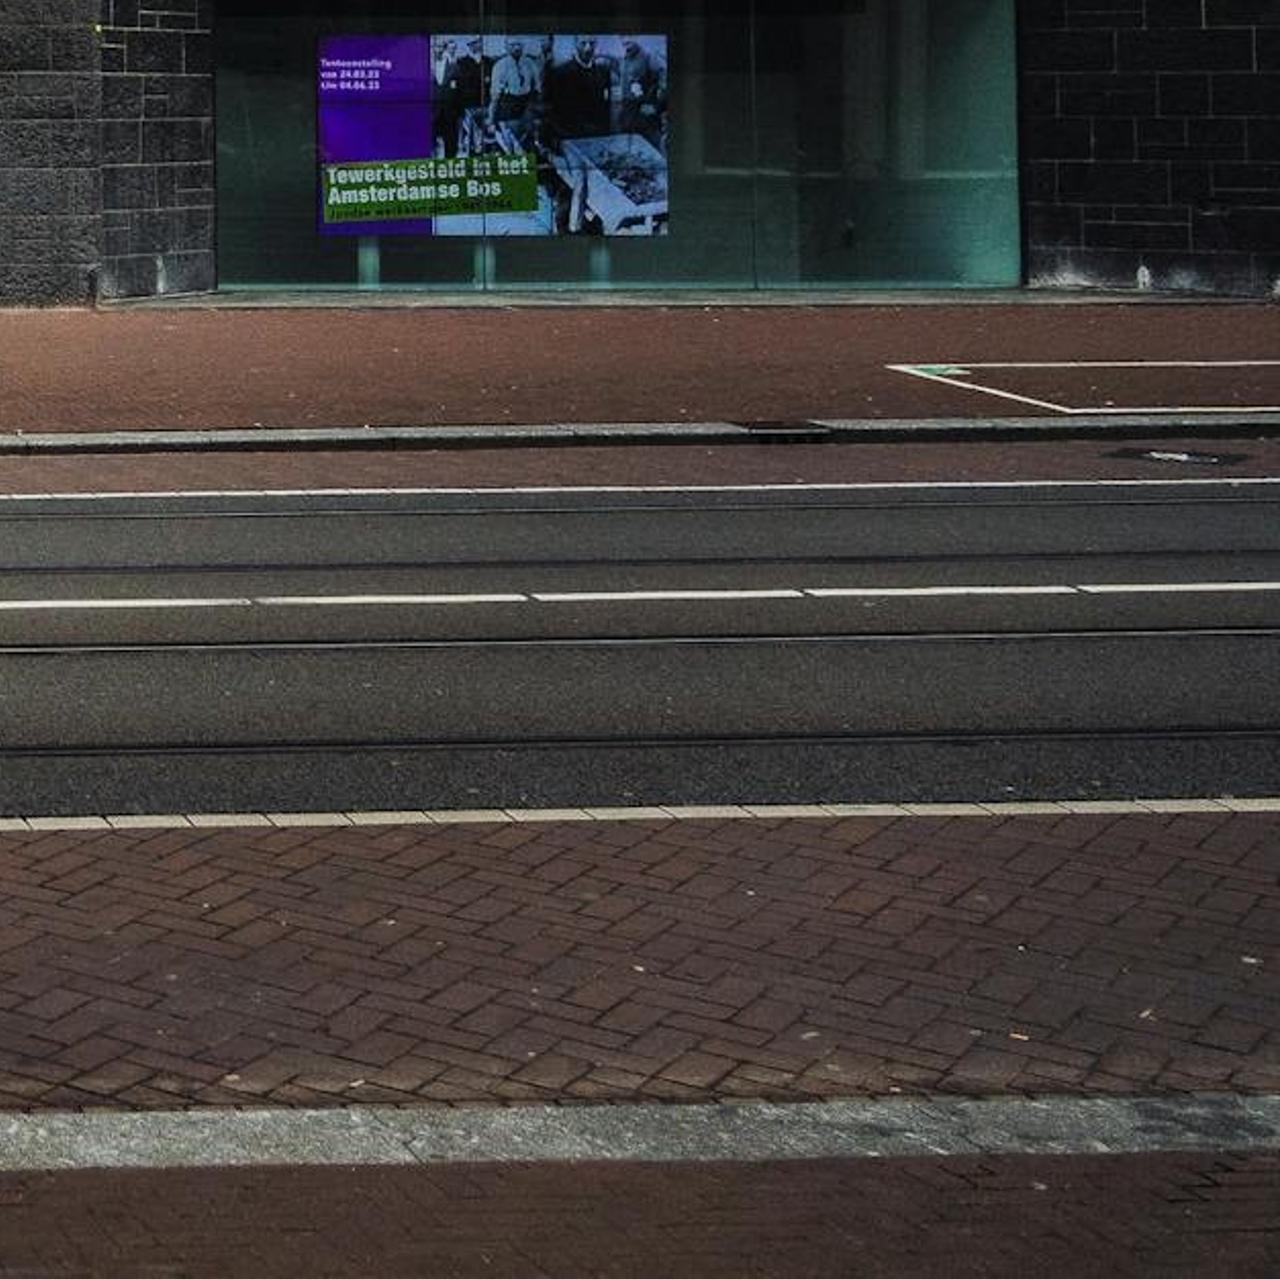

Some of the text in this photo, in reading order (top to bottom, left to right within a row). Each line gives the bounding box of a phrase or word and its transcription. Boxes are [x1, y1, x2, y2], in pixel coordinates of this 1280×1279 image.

[326, 156, 531, 185] Tewerkgesteld in het
[327, 179, 503, 206] Amsterdamse Bos
